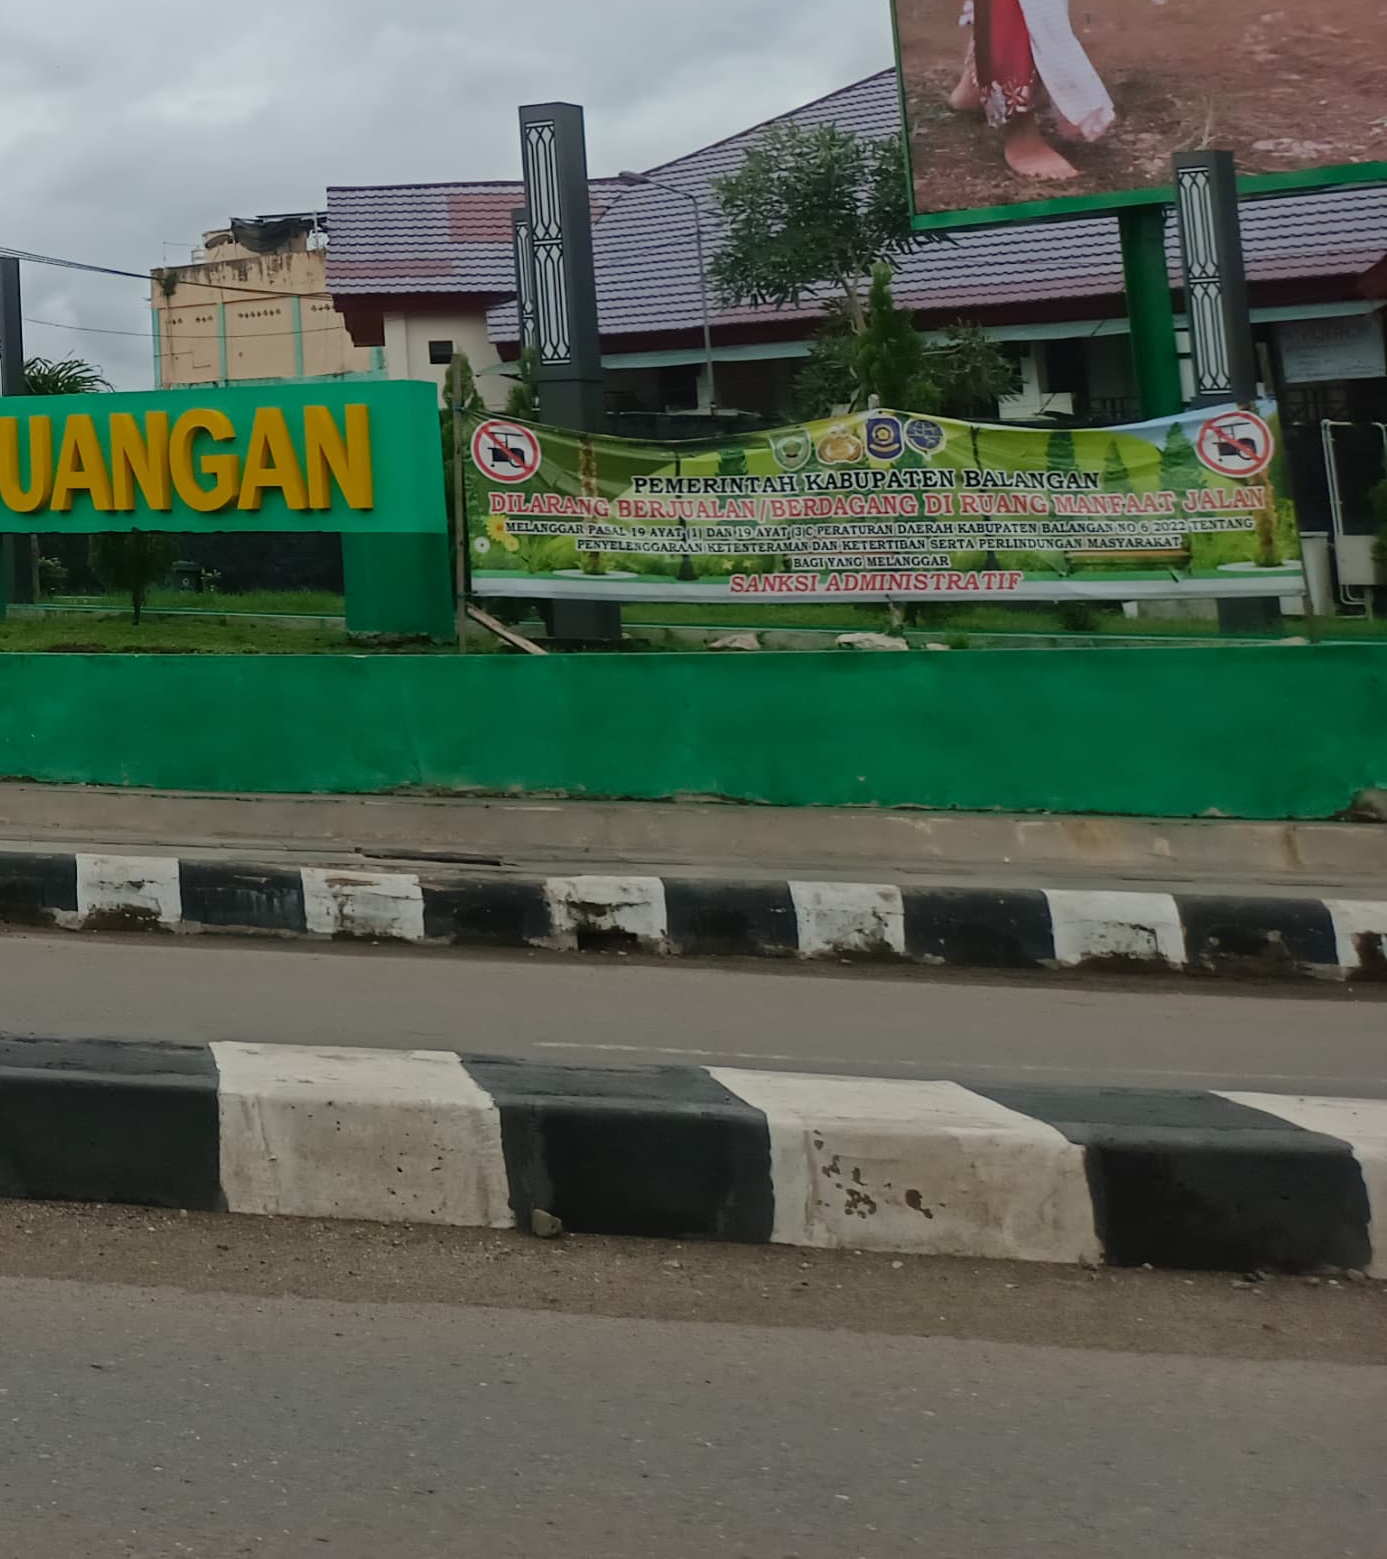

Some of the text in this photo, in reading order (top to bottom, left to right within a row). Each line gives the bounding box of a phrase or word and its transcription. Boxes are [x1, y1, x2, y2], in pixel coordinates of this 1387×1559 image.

[633, 470, 1100, 494] PEMERINTAH KABUPATEN BALANGAN
[490, 493, 610, 517] DILARANG
[925, 495, 953, 514] DI
[961, 494, 1047, 515] RUANG
[1054, 493, 1174, 514] MANFAAT
[1184, 488, 1265, 511] JALAN
[505, 522, 583, 535] MELANGGAR
[588, 524, 626, 536] PASAL
[631, 527, 646, 538] 19
[650, 527, 683, 538] AYAT
[687, 527, 702, 539] (1)
[707, 527, 732, 538] DAN
[738, 527, 752, 538] 19
[756, 526, 788, 537] AYAT
[817, 524, 894, 536] PERATURAN
[898, 523, 954, 535] DAERAH
[958, 522, 1037, 534] KABUPATEN
[1042, 522, 1113, 534] BALANGAN
[1118, 522, 1137, 533] NO
[1141, 522, 1149, 533] 6
[1154, 521, 1186, 532] 2022
[1191, 519, 1253, 531] TENTANG
[577, 537, 1179, 553] PENYELENGGARAAN KETENTERAMAN DAN KETERTIBAN SERTA PERLINDUNGAN MASYARAKAT
[794, 556, 949, 568] BAGI YANG MELANGGAR
[731, 572, 1022, 592] SANKSI ADMINISTRATIF
